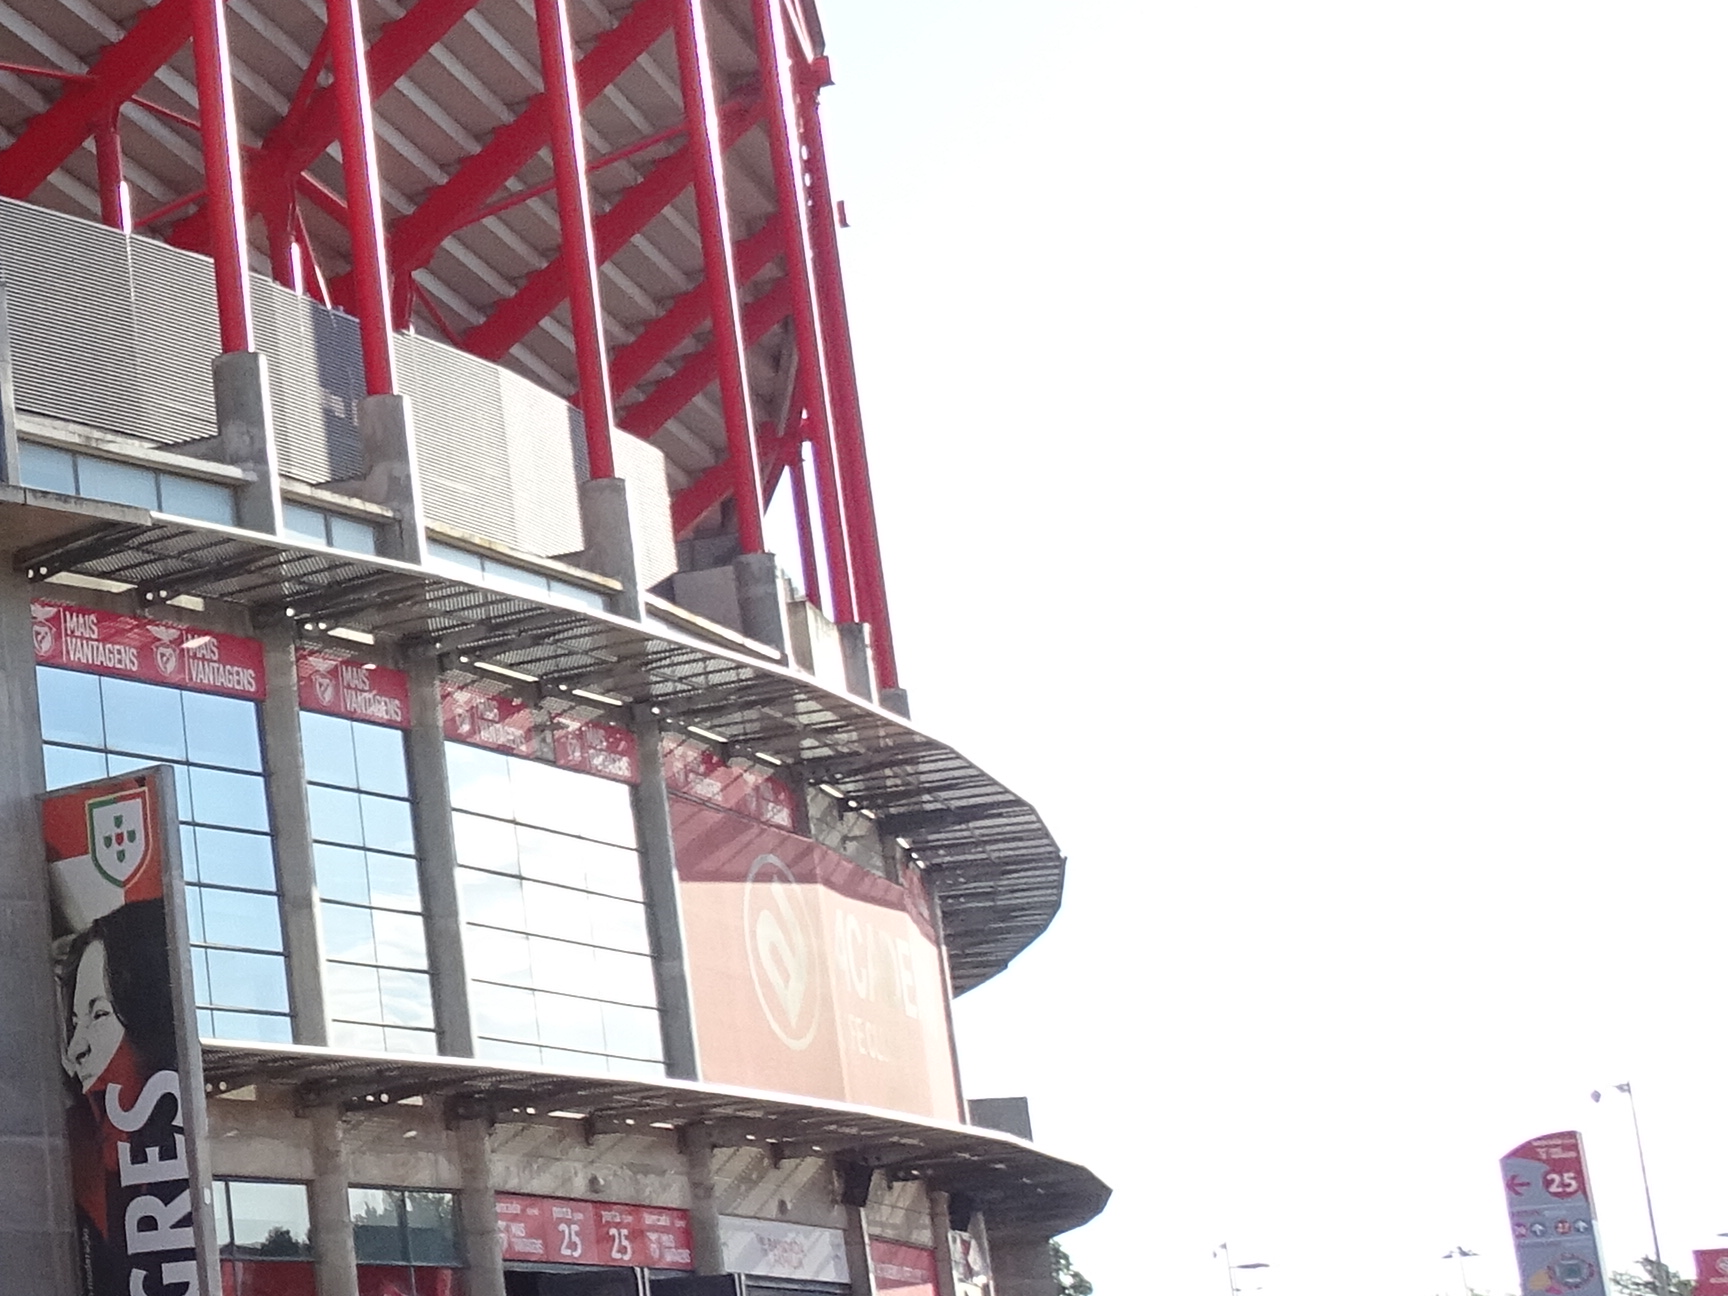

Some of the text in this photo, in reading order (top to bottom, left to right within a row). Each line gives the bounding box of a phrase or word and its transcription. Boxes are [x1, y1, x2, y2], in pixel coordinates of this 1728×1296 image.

[65, 611, 99, 639] MAIS
[66, 637, 139, 671] VANTAGENS
[189, 659, 256, 692] VANTAGENS
[343, 665, 369, 691] MAIS
[1546, 1172, 1578, 1193] 25
[558, 1223, 582, 1257] 25
[609, 1228, 632, 1260] 25
